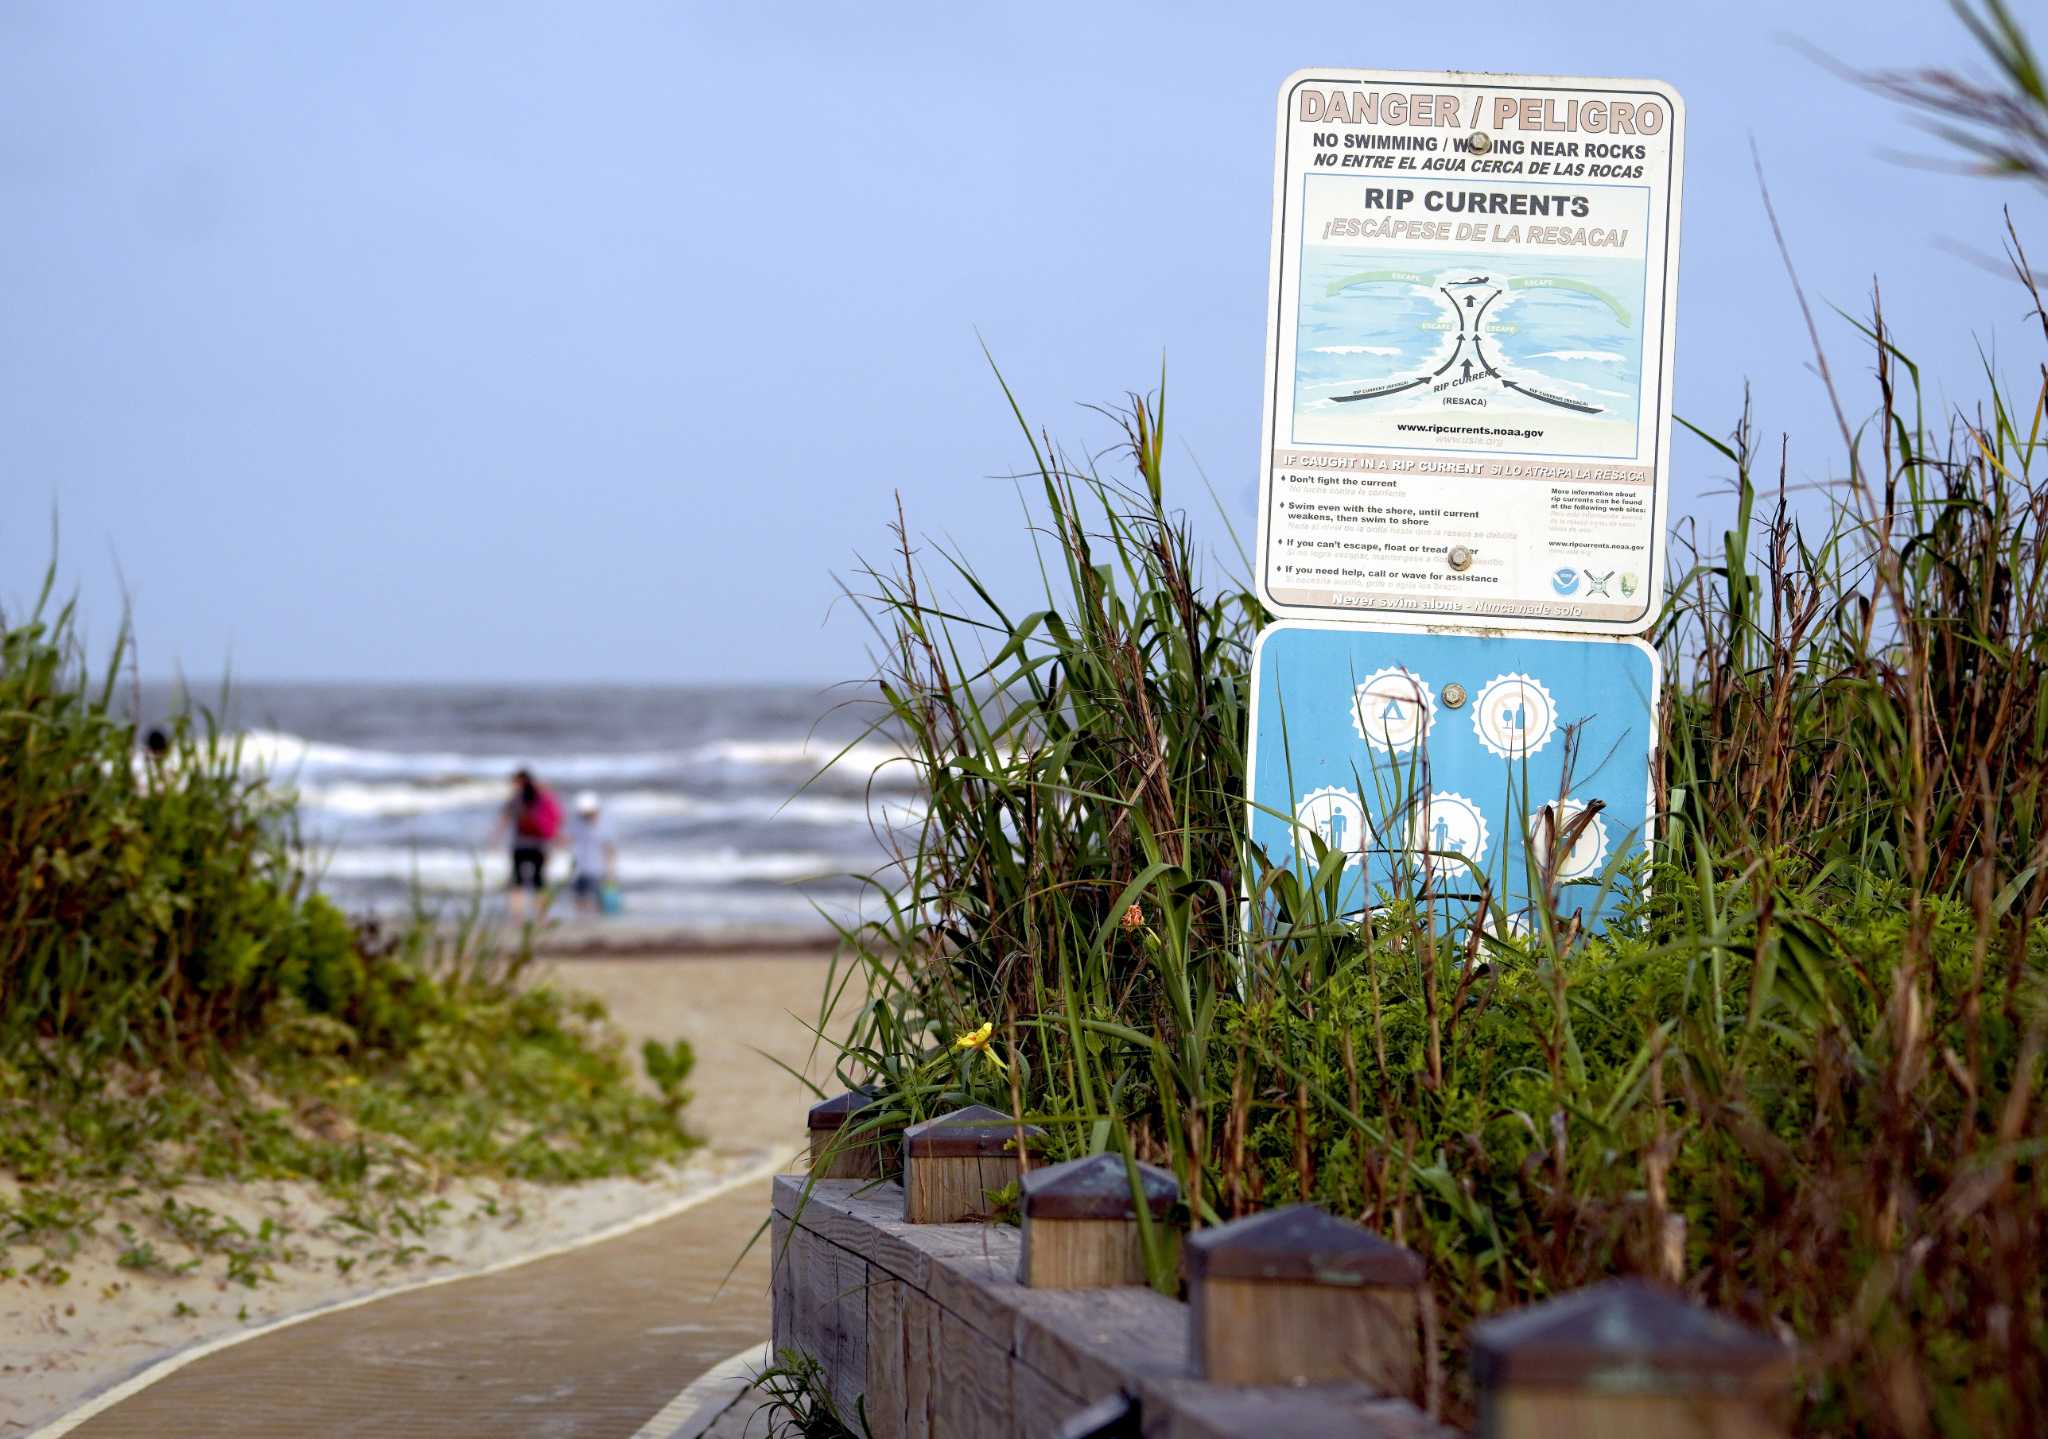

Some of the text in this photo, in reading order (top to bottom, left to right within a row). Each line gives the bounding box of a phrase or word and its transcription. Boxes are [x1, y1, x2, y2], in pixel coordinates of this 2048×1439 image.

[1300, 90, 1664, 136] DANGER / PELIGRO
[1313, 132, 1646, 160] NO SWIMMING / WING NEAR ROCKS
[1313, 153, 1644, 179] NO ENTRE EL AGUA CERCA DE LAS ROCAS
[1364, 188, 1590, 218] RIP CURRENTS
[1322, 216, 1629, 248] ¡ESCÁPESE DE LA RESACA!
[1433, 382, 1449, 393] RIP
[1442, 397, 1487, 408] (RESACA)
[1397, 423, 1544, 439] www.ripcurrents.noaa.gov
[1283, 455, 1484, 475] IF CAUGHT IN A RIP CURRENT
[1289, 475, 1397, 488] Don't fight the current
[1489, 465, 1647, 482] SI LO ATRAPA LA RESACA
[1571, 489, 1613, 497] information
[1288, 502, 1479, 518] Swim even with the shore, until current
[1574, 504, 1607, 513] following
[1621, 498, 1643, 506] found
[1288, 512, 1429, 526] weakens, then swim to shore
[1297, 540, 1314, 549] you
[1316, 540, 1341, 549] can't
[1343, 543, 1382, 552] escape,
[1384, 543, 1407, 552] float
[1409, 545, 1420, 553] or
[1422, 546, 1448, 554] tread
[1548, 541, 1645, 551] www.ripcurrents.noaa.gov
[1285, 565, 1293, 573] If
[1295, 567, 1312, 575] you
[1315, 567, 1339, 575] need
[1342, 568, 1365, 578] help,
[1368, 569, 1386, 577] call
[1402, 572, 1427, 580] wave
[1429, 572, 1443, 581] for
[1445, 573, 1498, 583] assistance
[1332, 593, 1375, 607] Never
[1380, 596, 1418, 609] swim
[1423, 598, 1463, 611] alone
[1474, 600, 1516, 614] Nunca
[1517, 602, 1551, 615] nade
[1553, 604, 1583, 617] solo
